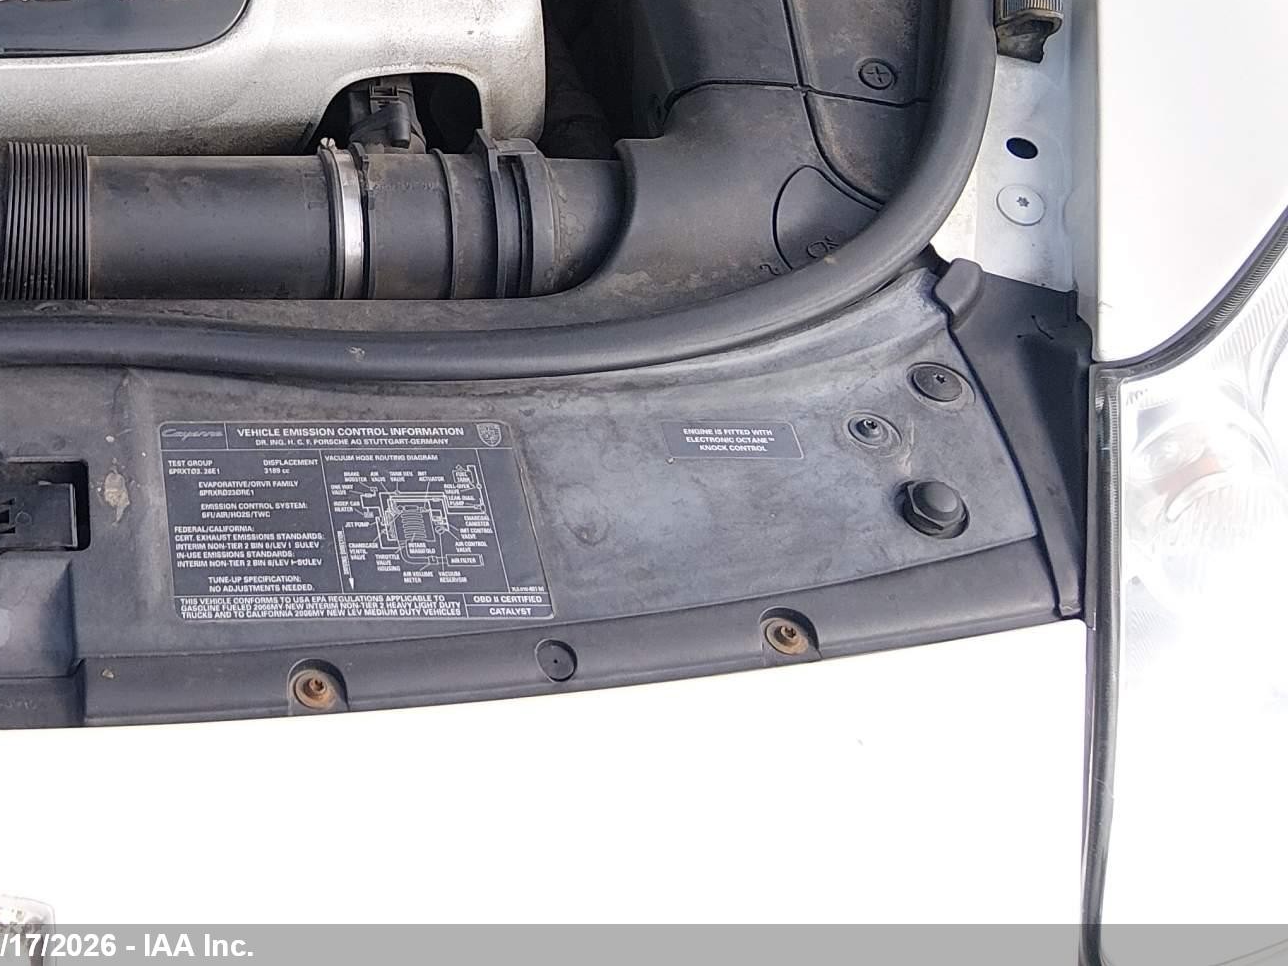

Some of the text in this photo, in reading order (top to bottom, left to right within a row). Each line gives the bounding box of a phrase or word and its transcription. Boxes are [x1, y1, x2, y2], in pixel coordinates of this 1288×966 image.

[237, 427, 464, 436] VEHICLE EMISSION CONTROL INFORMATION
[176, 551, 202, 559] IN-USE
[247, 559, 251, 567] 2
[209, 585, 222, 593] NO
[222, 584, 281, 592] ADJUSTMENTS
[293, 596, 309, 604] USA
[473, 595, 491, 603] OBD
[501, 595, 542, 603] CERTIFIED
[489, 608, 532, 616] CATALYST
